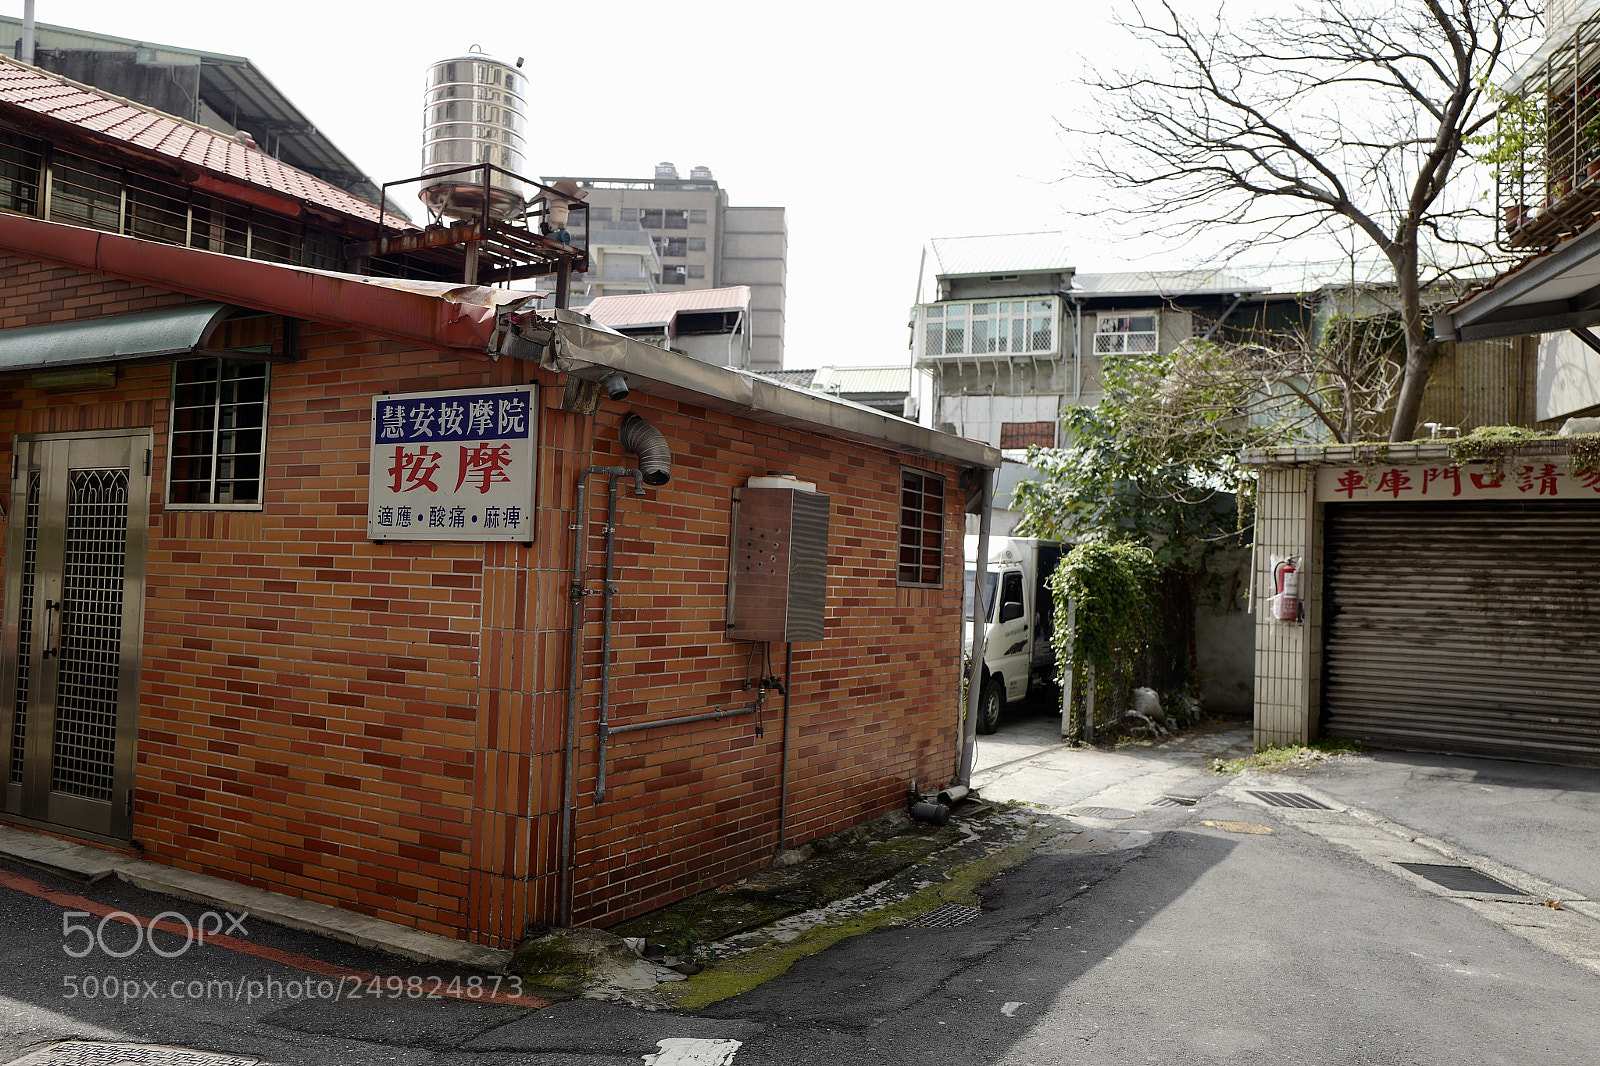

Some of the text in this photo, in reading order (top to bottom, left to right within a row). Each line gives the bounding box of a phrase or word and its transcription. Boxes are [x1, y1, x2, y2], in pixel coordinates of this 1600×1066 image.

[380, 397, 526, 439] 慧安按摩院
[387, 442, 513, 494] 按摩
